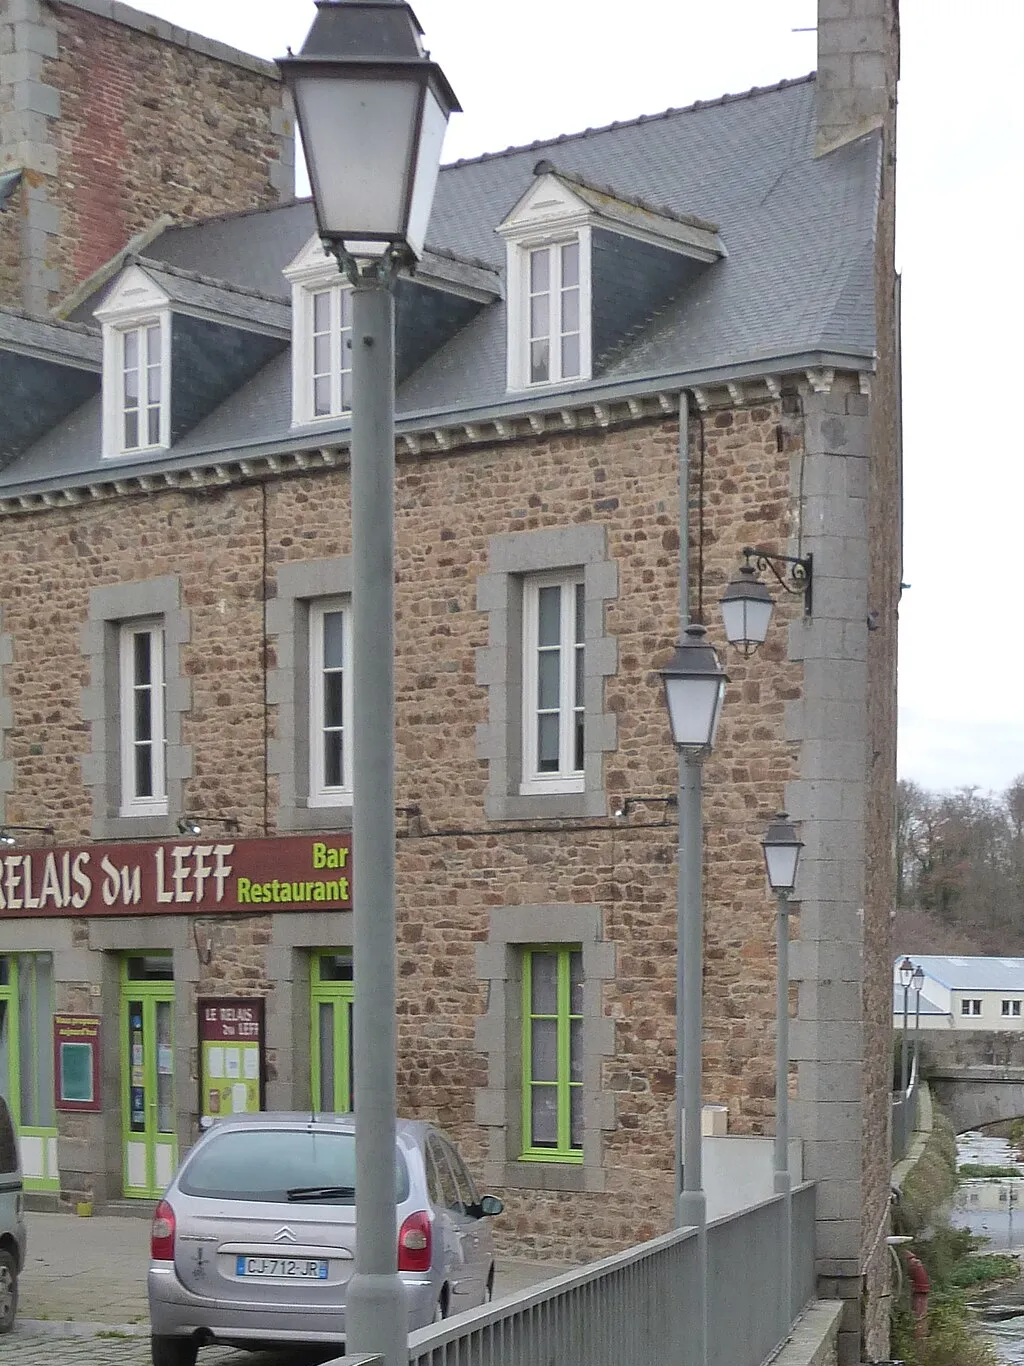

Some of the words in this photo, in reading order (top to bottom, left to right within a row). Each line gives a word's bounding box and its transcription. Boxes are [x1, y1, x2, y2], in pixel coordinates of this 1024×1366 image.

[312, 842, 349, 869] Bar
[100, 854, 142, 906] du
[155, 844, 235, 903] LEFF
[237, 877, 349, 903] Restaurant
[205, 1008, 217, 1021] LE
